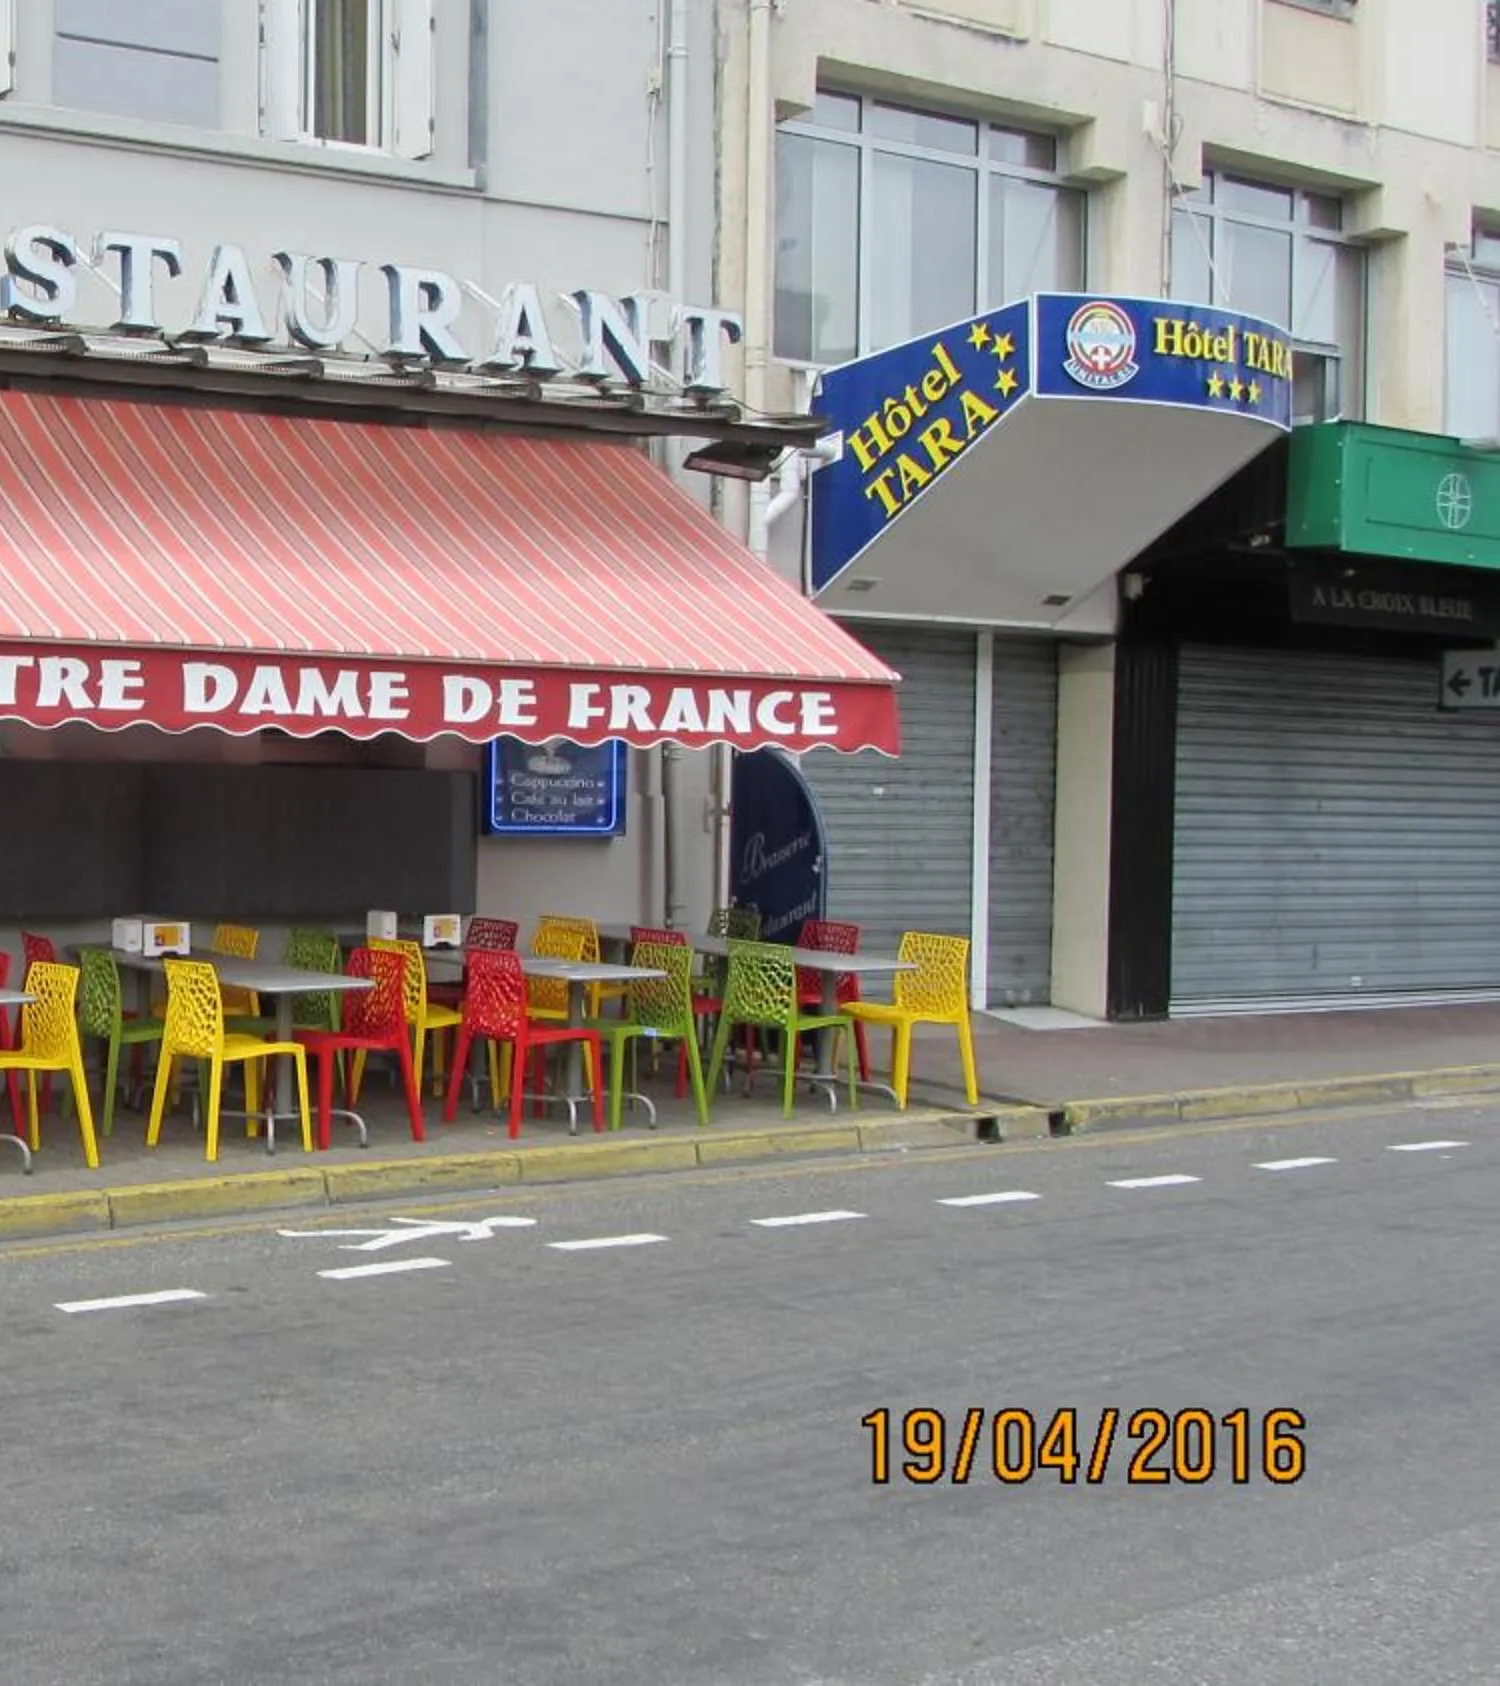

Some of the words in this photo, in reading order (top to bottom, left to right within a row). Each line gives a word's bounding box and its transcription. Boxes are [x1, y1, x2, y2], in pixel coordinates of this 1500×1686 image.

[1153, 317, 1237, 363] Hôtel
[846, 342, 962, 473] Hôtel
[865, 390, 999, 519] TARA
[183, 661, 410, 720] DAME
[443, 674, 539, 728] DE
[567, 682, 838, 736] FRANCE
[511, 773, 594, 788] Cappuccino
[511, 808, 576, 823] Chocolat
